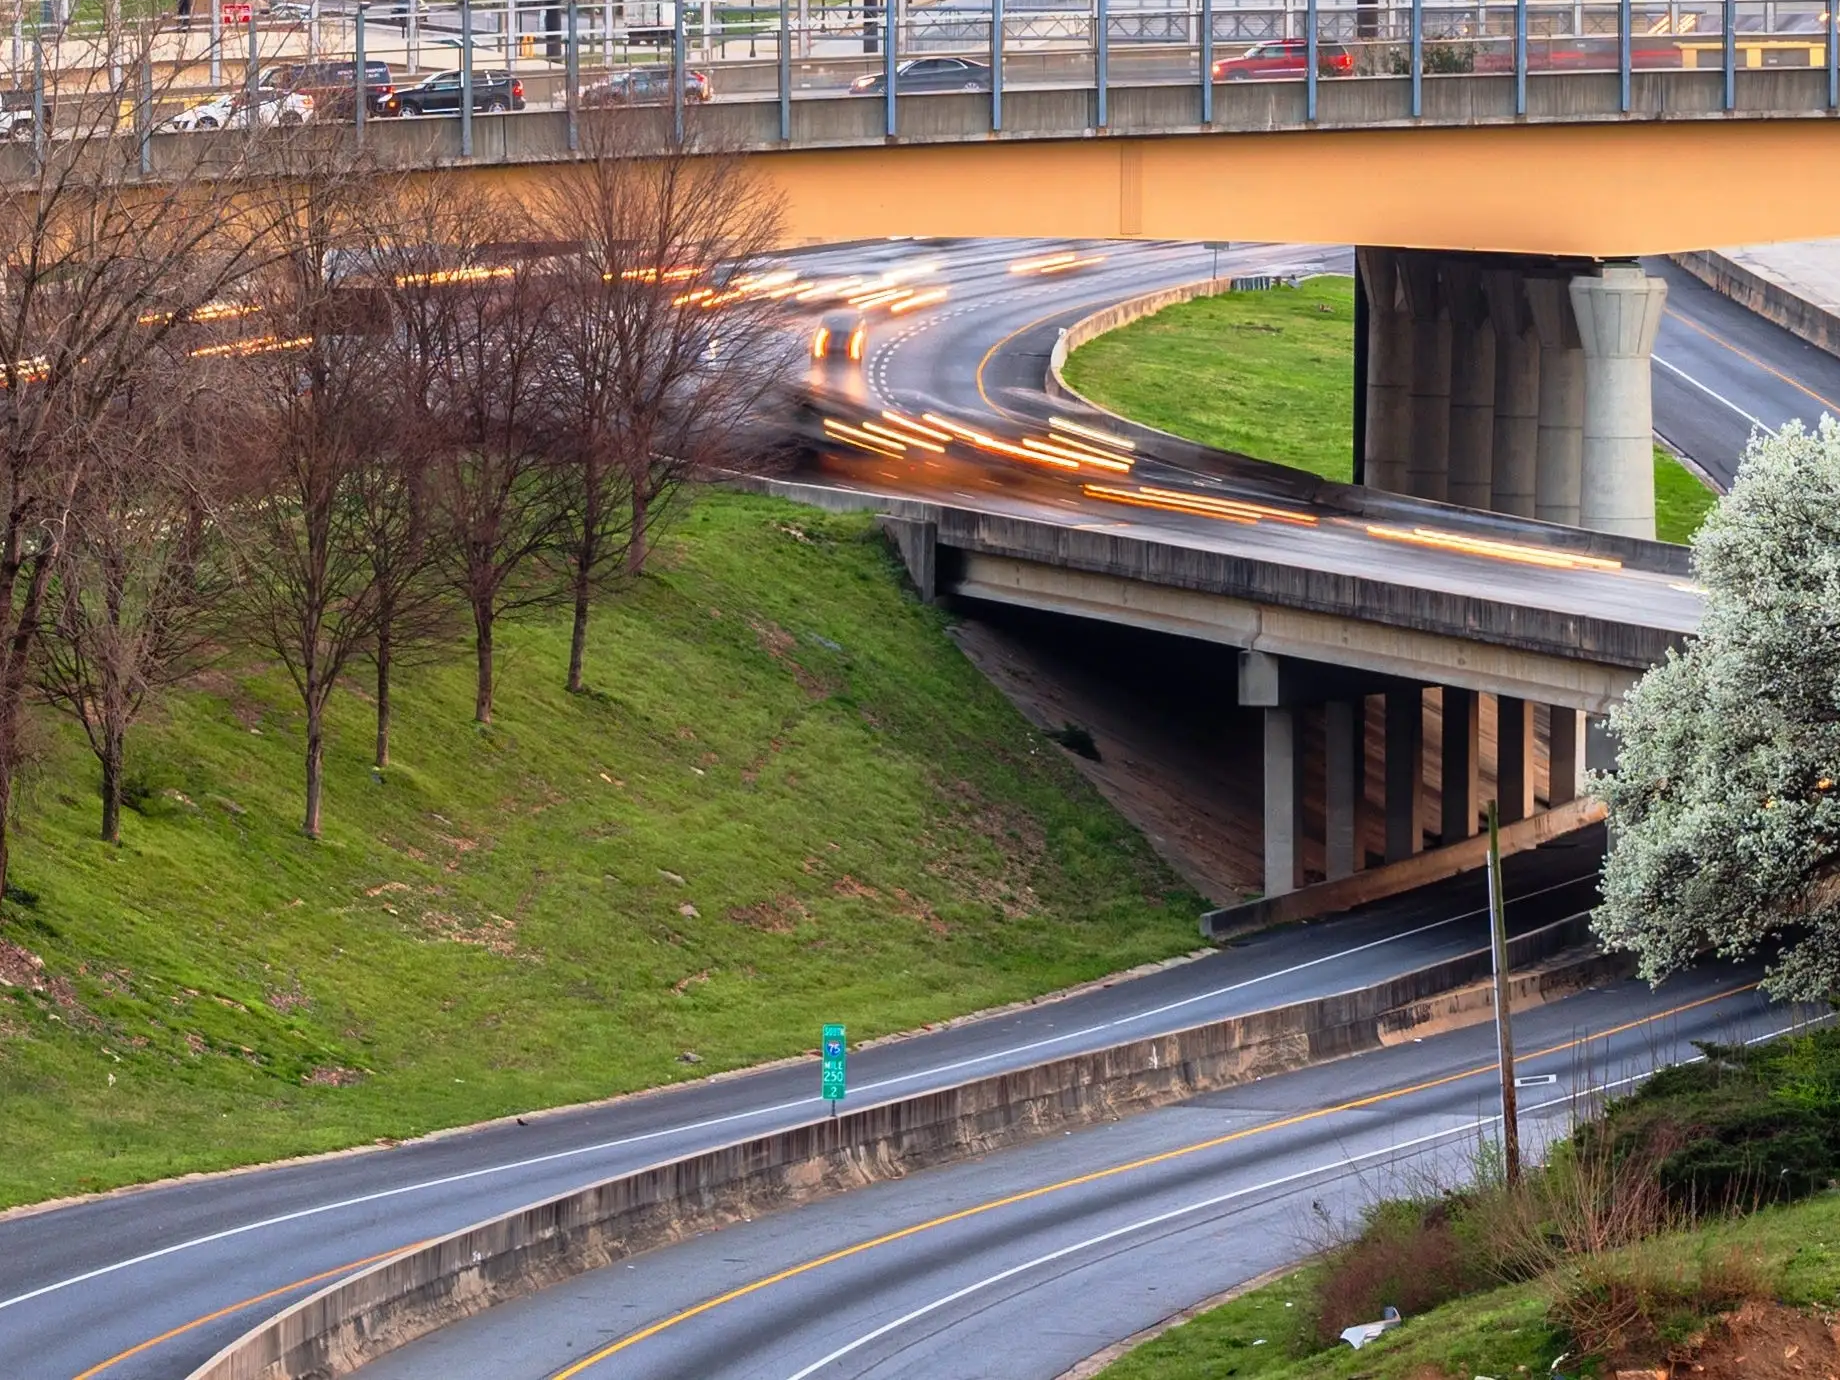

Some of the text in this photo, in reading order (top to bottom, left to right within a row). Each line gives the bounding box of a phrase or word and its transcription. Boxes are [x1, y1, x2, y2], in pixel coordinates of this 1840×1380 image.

[824, 1027, 845, 1037] SOUTH
[828, 1043, 841, 1054] 75
[824, 1061, 843, 1070] MILE
[824, 1071, 843, 1082] 250
